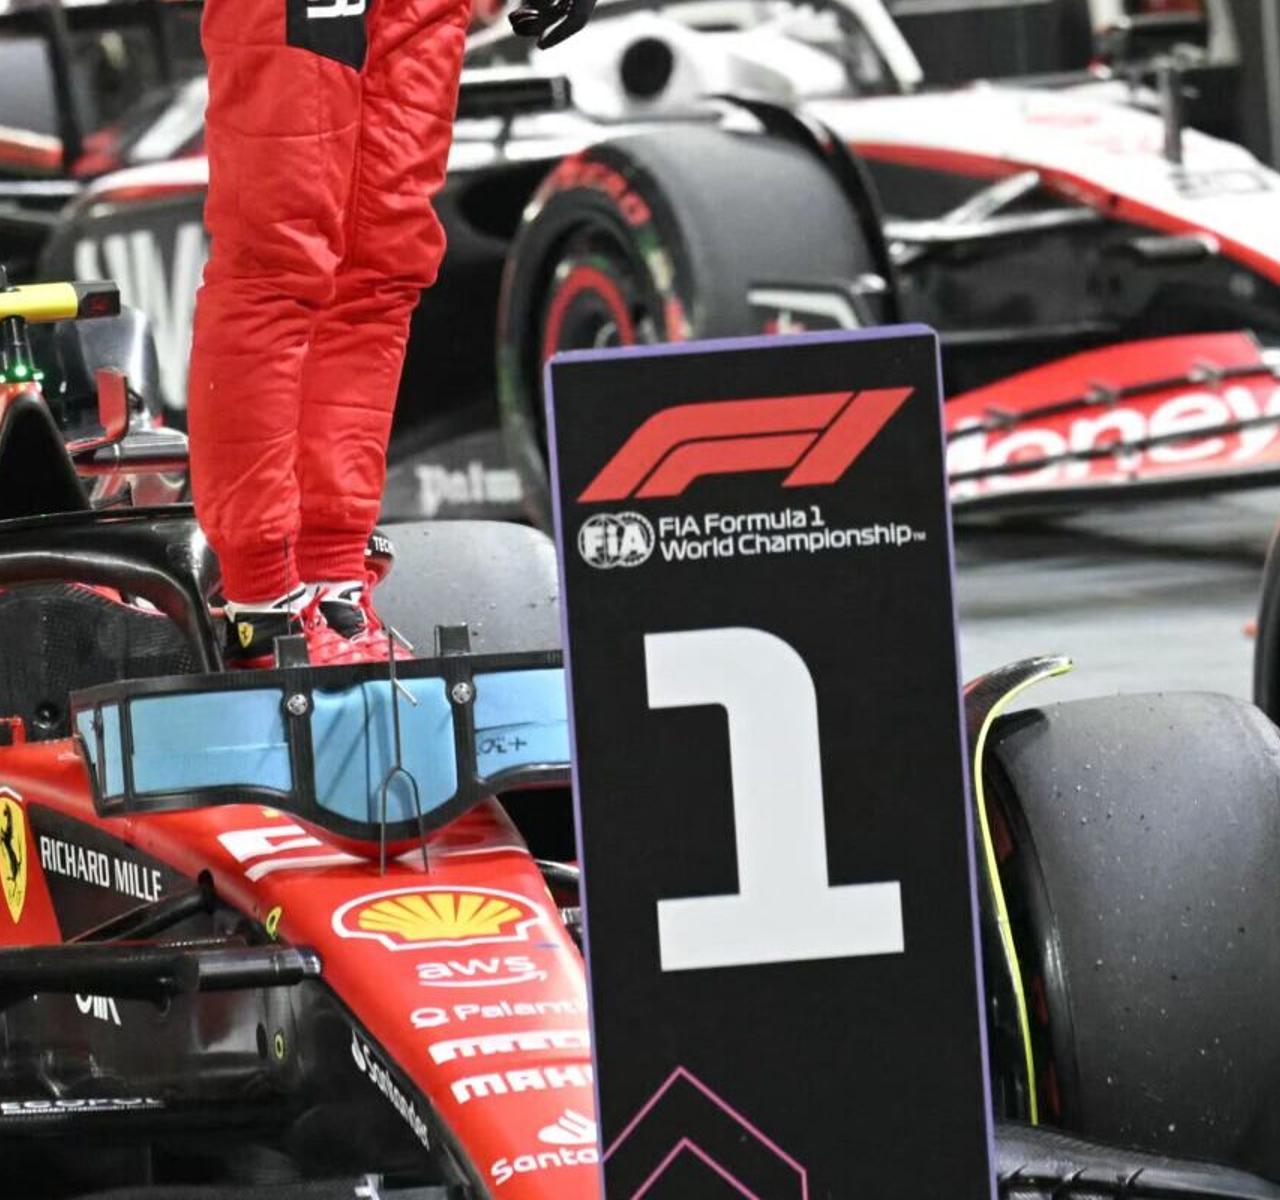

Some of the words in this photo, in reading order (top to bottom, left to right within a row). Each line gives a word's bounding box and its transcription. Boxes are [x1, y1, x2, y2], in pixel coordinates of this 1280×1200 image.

[658, 515, 701, 538] FIA
[705, 507, 808, 534] Formula
[810, 505, 825, 527] 1
[660, 534, 733, 561] World
[644, 626, 905, 971] 1
[39, 835, 111, 888] RICHARD
[416, 956, 538, 981] aws
